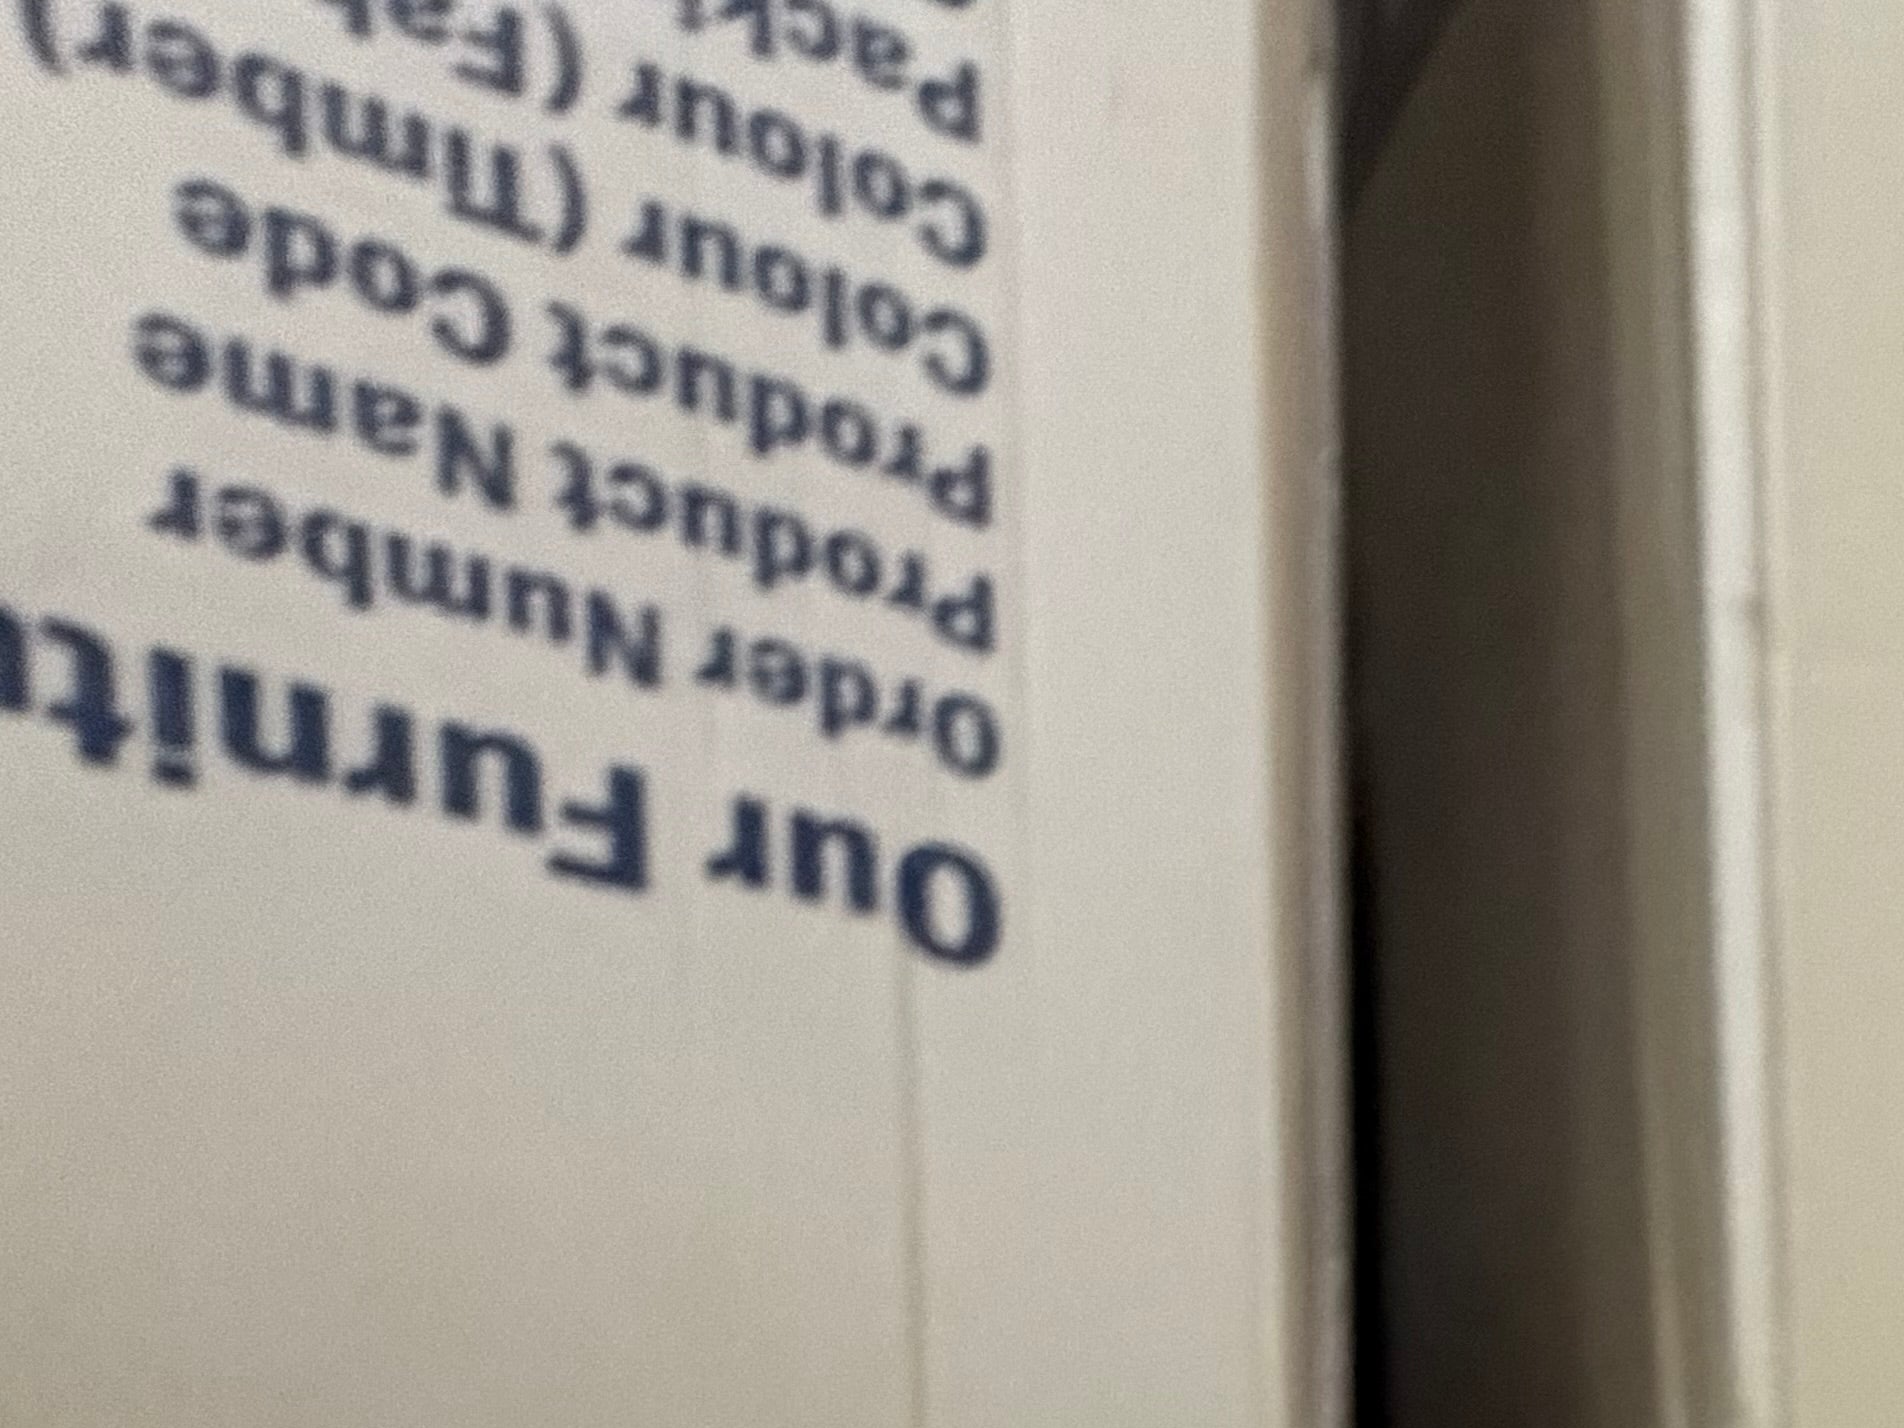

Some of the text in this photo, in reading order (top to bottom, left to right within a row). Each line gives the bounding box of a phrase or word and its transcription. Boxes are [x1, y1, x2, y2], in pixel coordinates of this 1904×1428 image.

[614, 60, 990, 270] Colour
[620, 200, 992, 398] Colour
[132, 310, 997, 654] Product Name
[170, 176, 992, 528] Product Code
[146, 466, 1001, 780] Order Number
[0, 609, 1003, 971] Our Furnit
